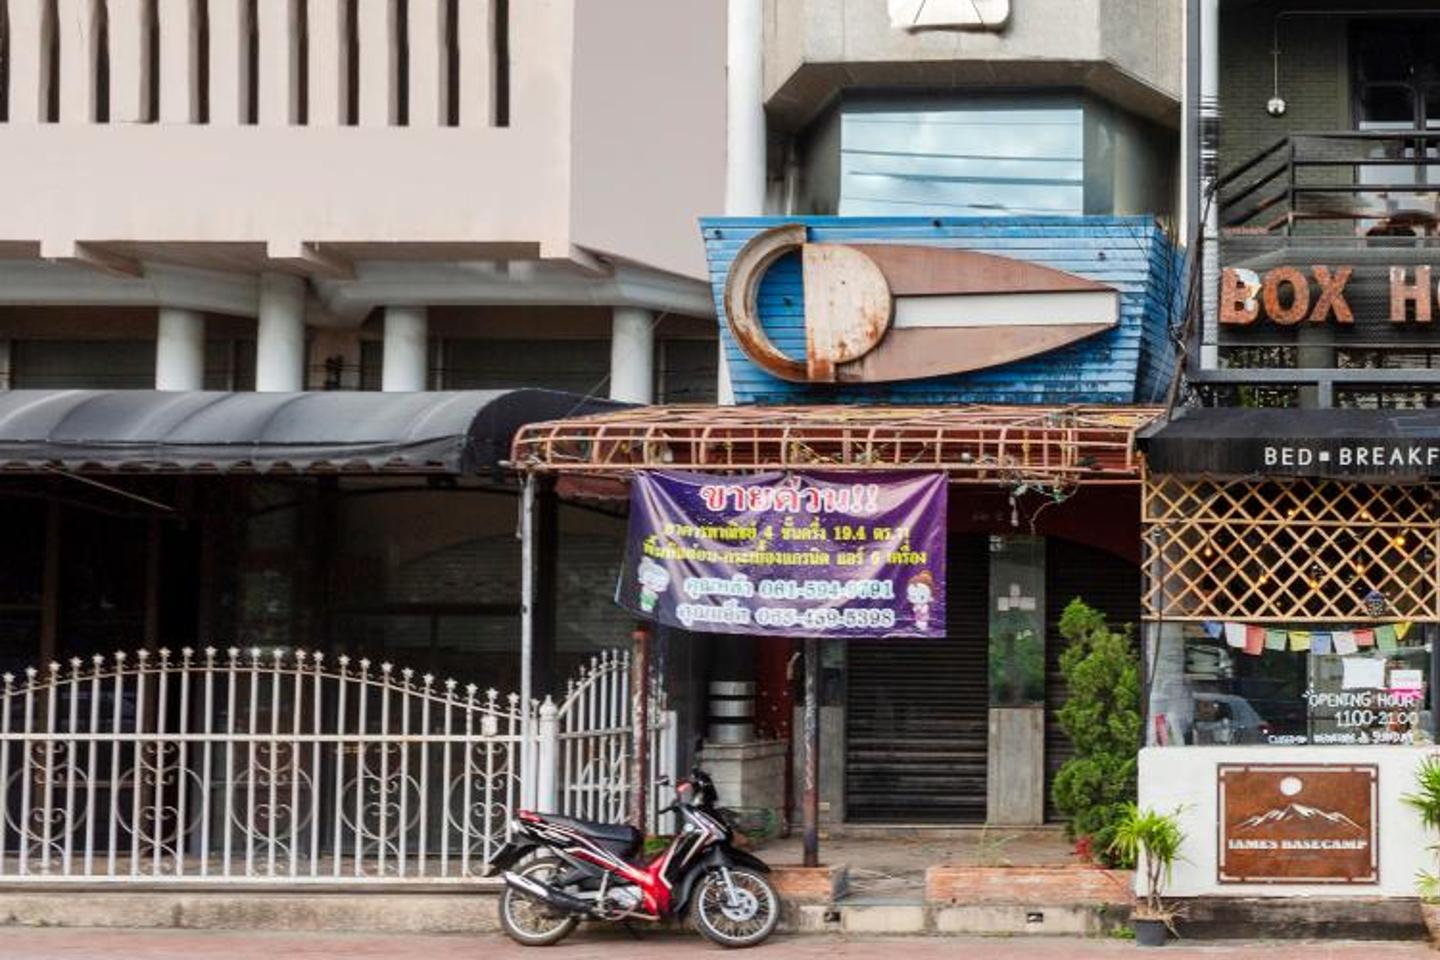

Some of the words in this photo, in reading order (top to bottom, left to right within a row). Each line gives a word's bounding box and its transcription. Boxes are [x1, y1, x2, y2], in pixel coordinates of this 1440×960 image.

[1219, 266, 1354, 325] BOX
[1264, 446, 1313, 466] BED
[833, 525, 866, 541] 19.4
[1309, 691, 1371, 707] OPENING
